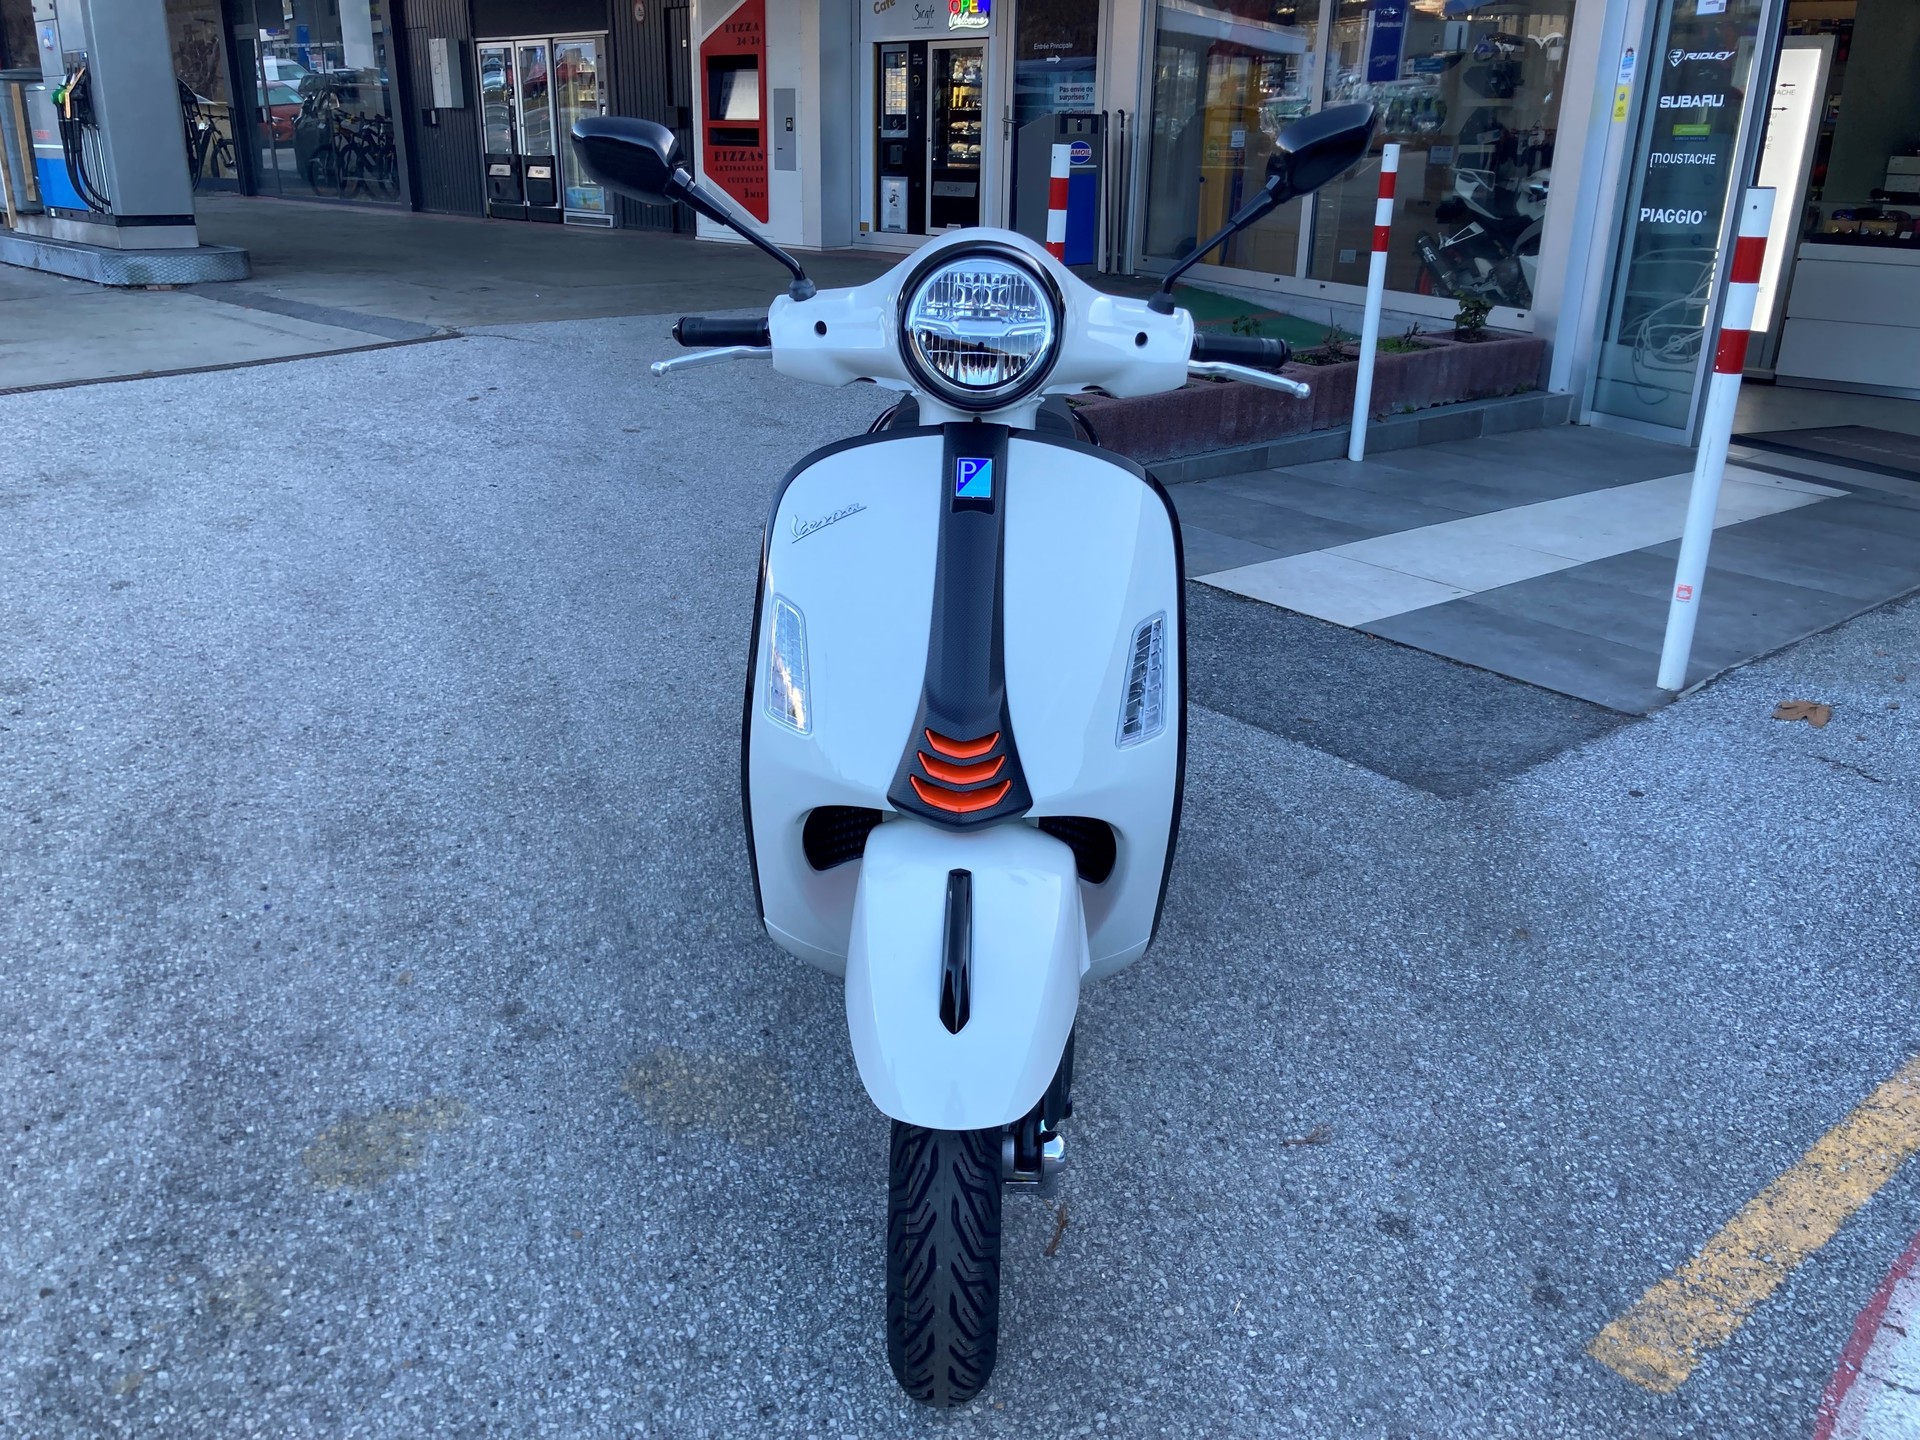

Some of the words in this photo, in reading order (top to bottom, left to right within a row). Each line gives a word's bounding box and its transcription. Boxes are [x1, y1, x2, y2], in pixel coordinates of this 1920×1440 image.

[725, 22, 759, 32] PIZZA
[948, 12, 989, 30] Welcome
[1050, 42, 1073, 50] Principale
[1684, 51, 1735, 61] RIDLEY
[1660, 95, 1724, 108] SUBARU
[714, 151, 763, 161] PIZZAS
[1650, 152, 1717, 168] MOUSTACHE
[1640, 208, 1703, 225] PIAGGIO
[959, 460, 977, 483] P
[790, 502, 867, 544] Vespa
